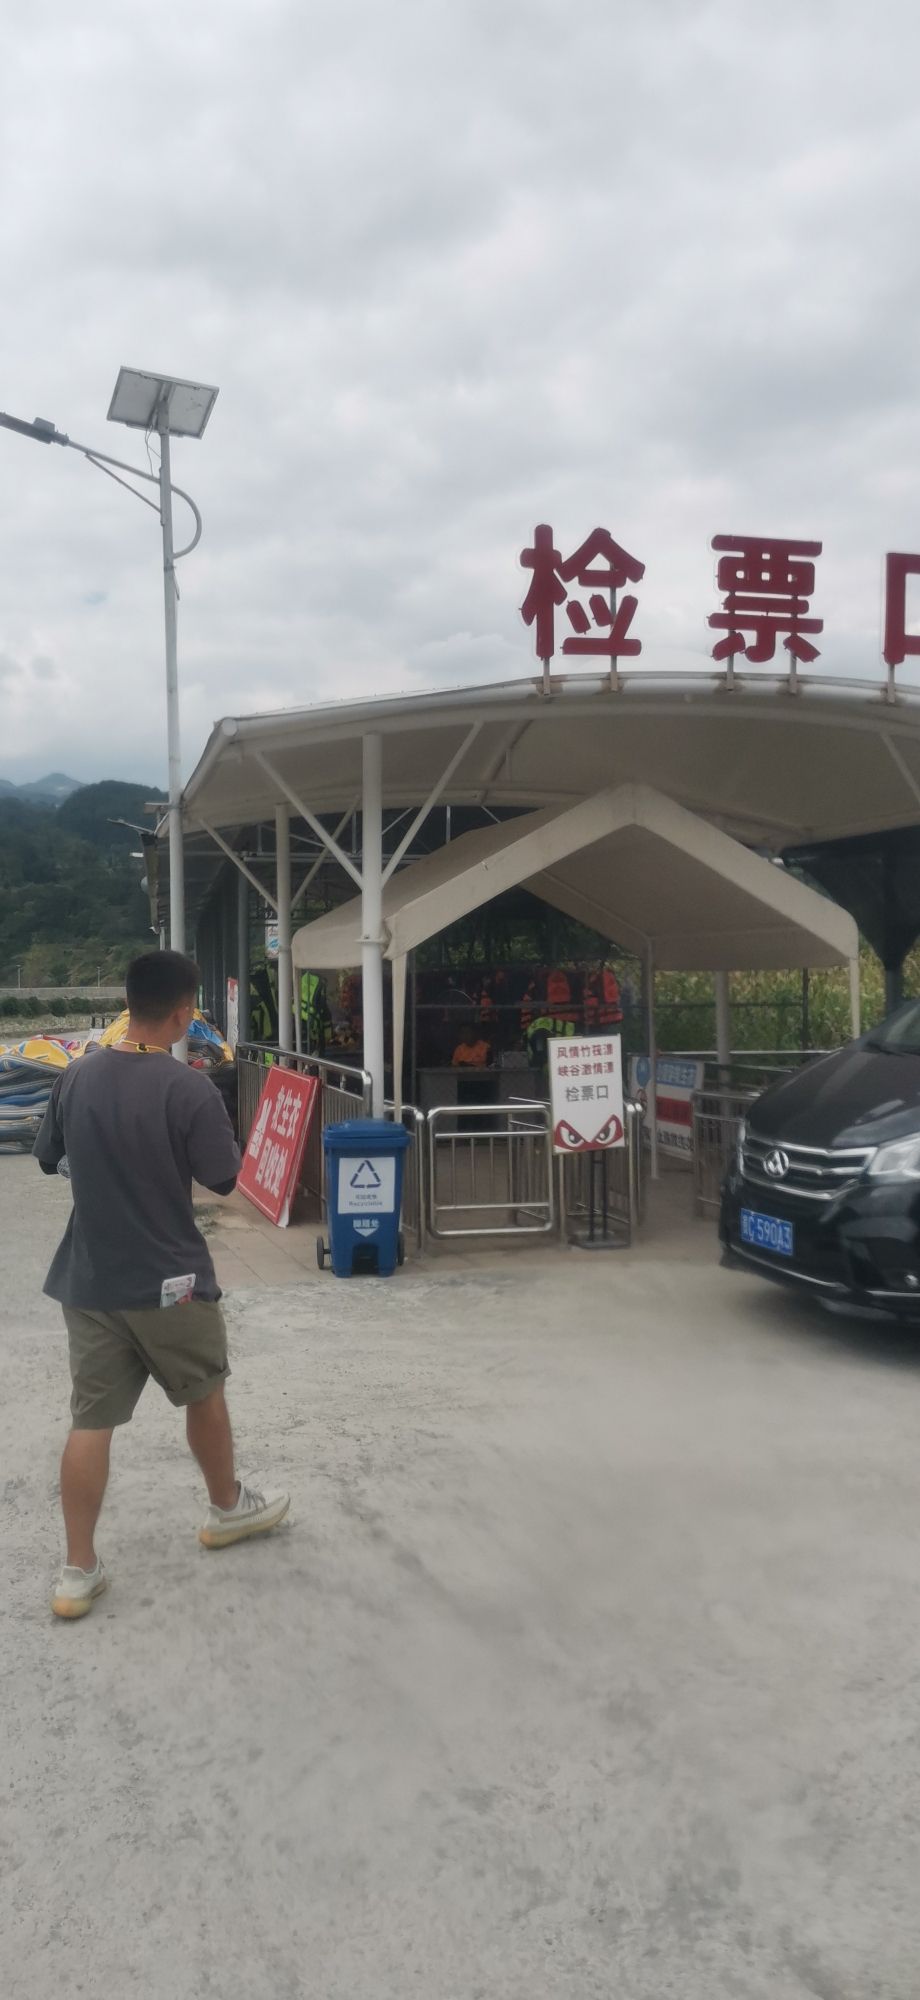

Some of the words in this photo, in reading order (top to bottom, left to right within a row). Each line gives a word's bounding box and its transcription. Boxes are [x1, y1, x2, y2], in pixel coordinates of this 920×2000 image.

[558, 1061, 614, 1077] 峡谷激情漂
[565, 1085, 609, 1102] 检票口
[270, 1085, 302, 1139] 救生衣
